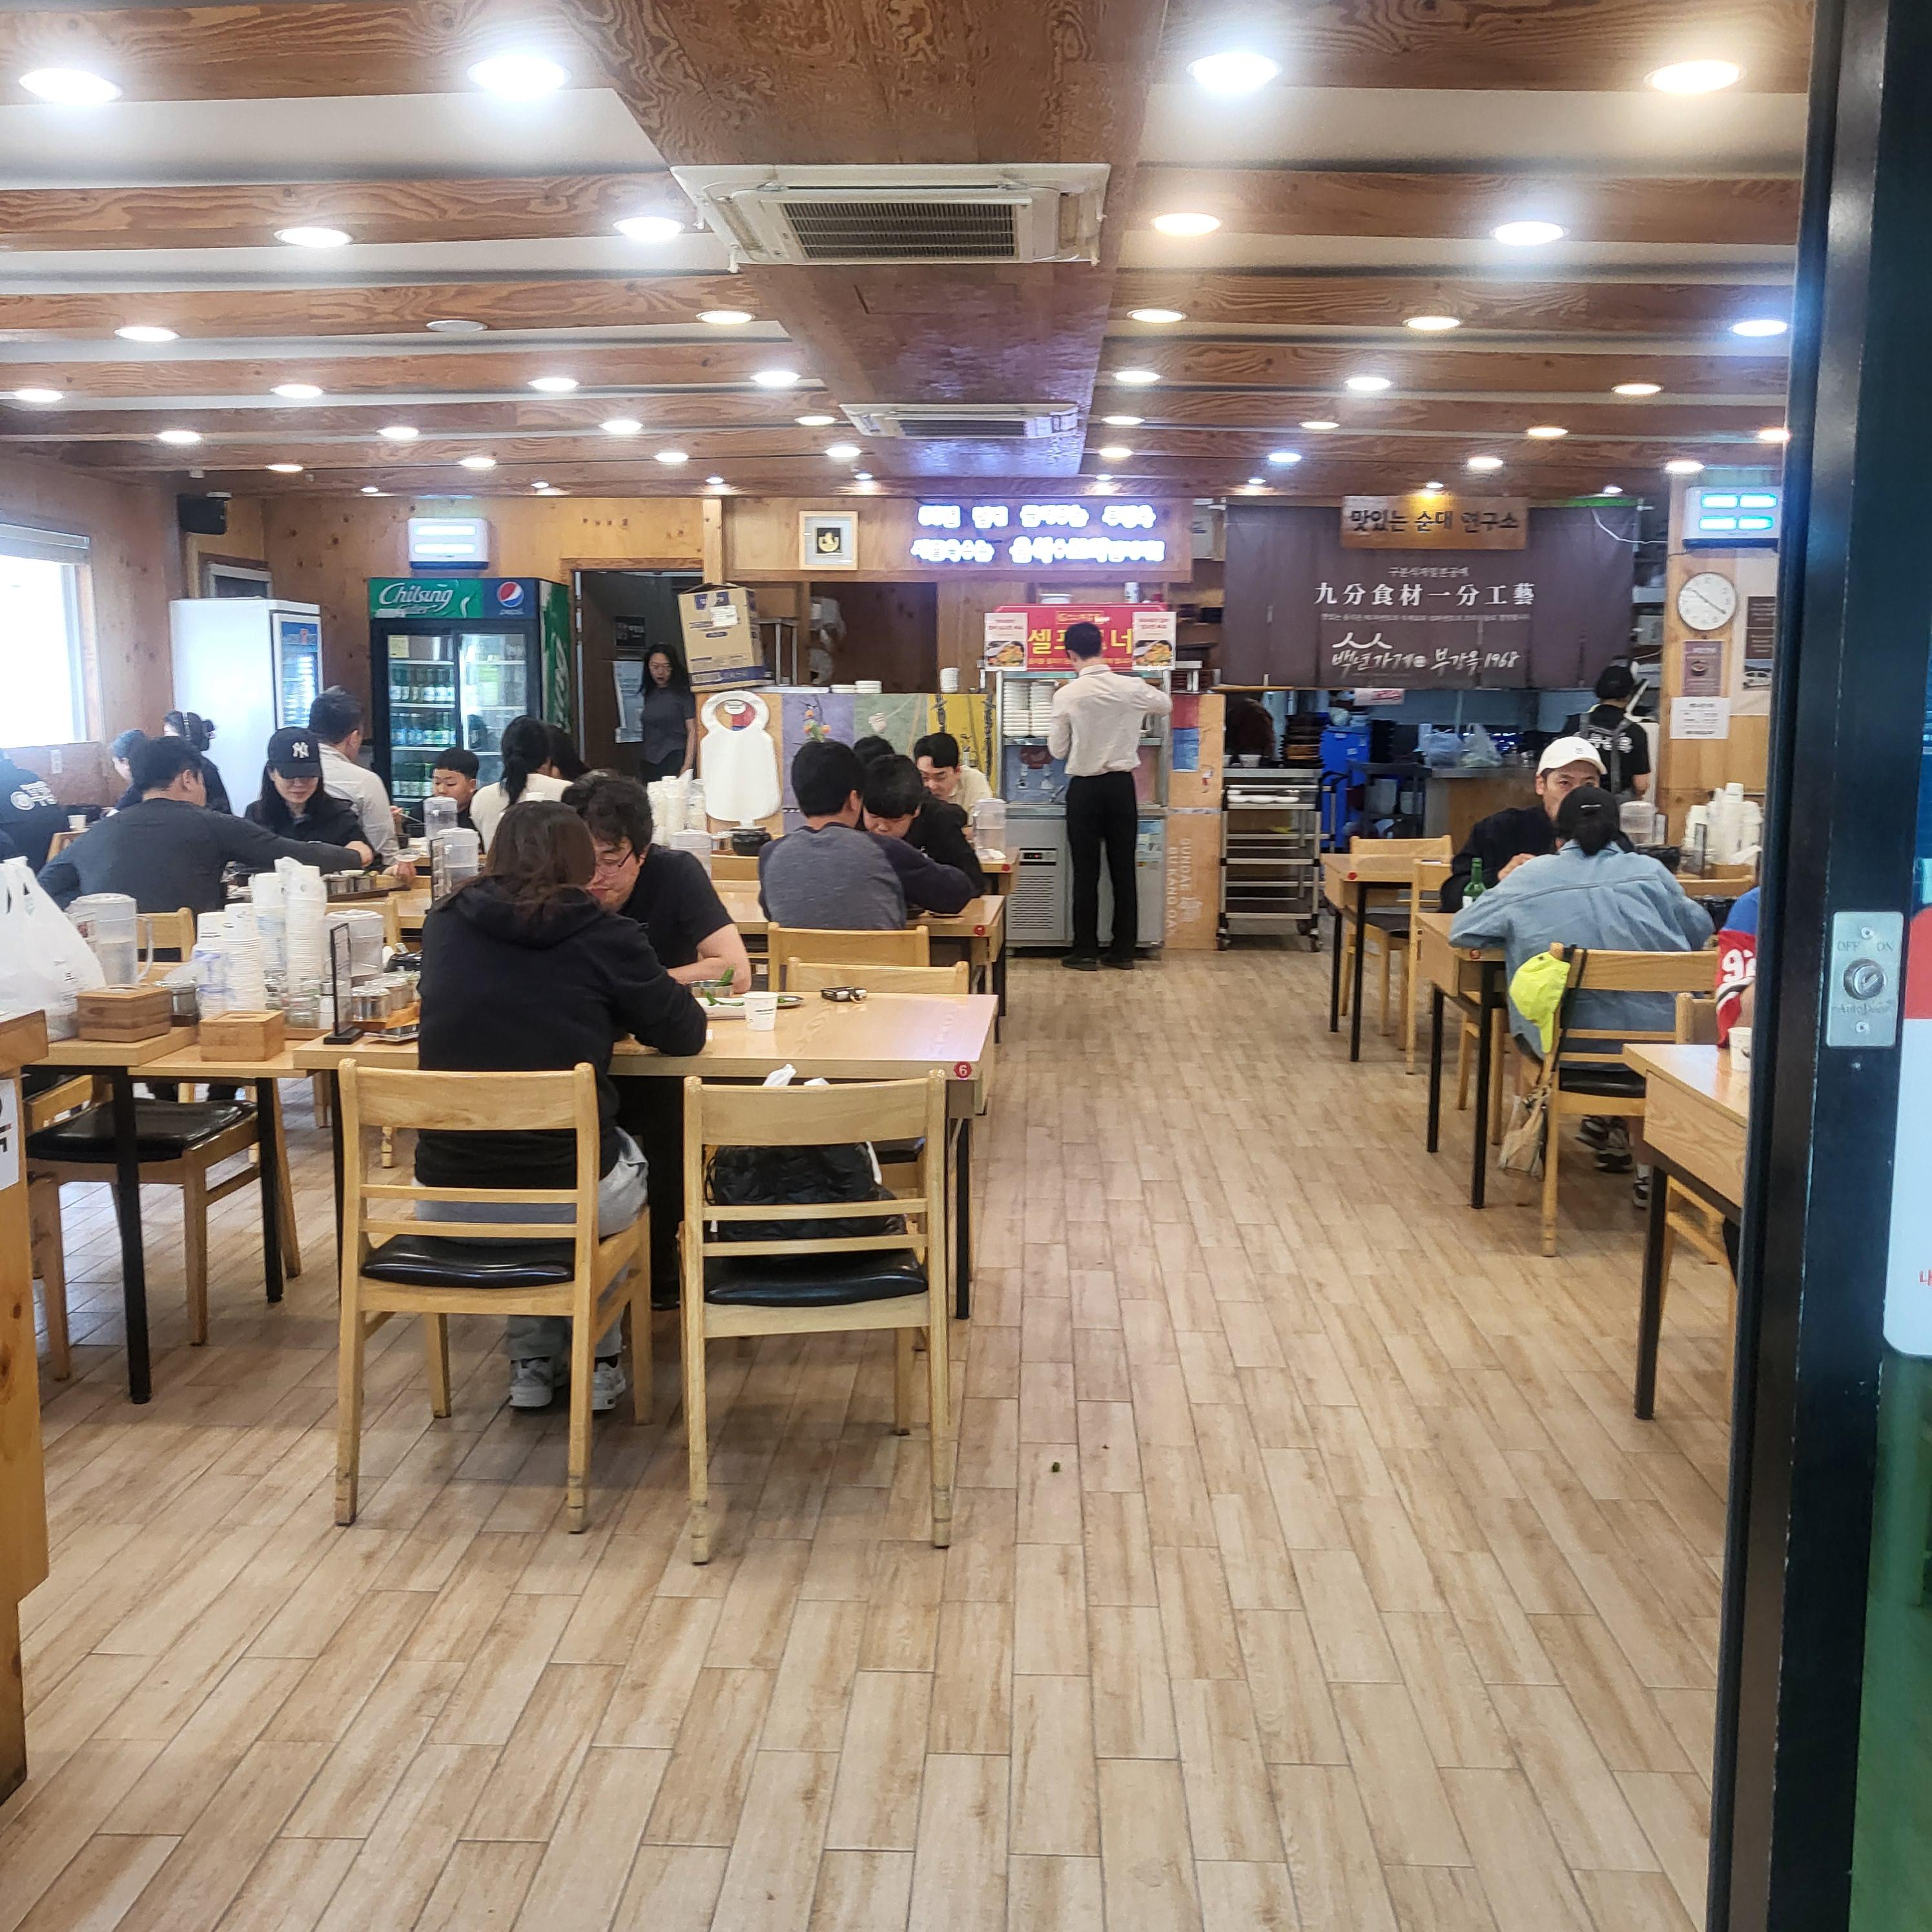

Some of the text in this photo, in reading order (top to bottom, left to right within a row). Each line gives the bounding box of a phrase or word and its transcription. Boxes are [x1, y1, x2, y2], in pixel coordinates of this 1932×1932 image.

[1351, 510, 1519, 533] 맛있는 순대 연구소
[1313, 582, 1535, 607] 九分食材一分工藝
[1484, 651, 1521, 668] 1968
[291, 741, 310, 759] NY
[1837, 941, 1894, 952] OFF ON
[958, 1065, 968, 1076] 6
